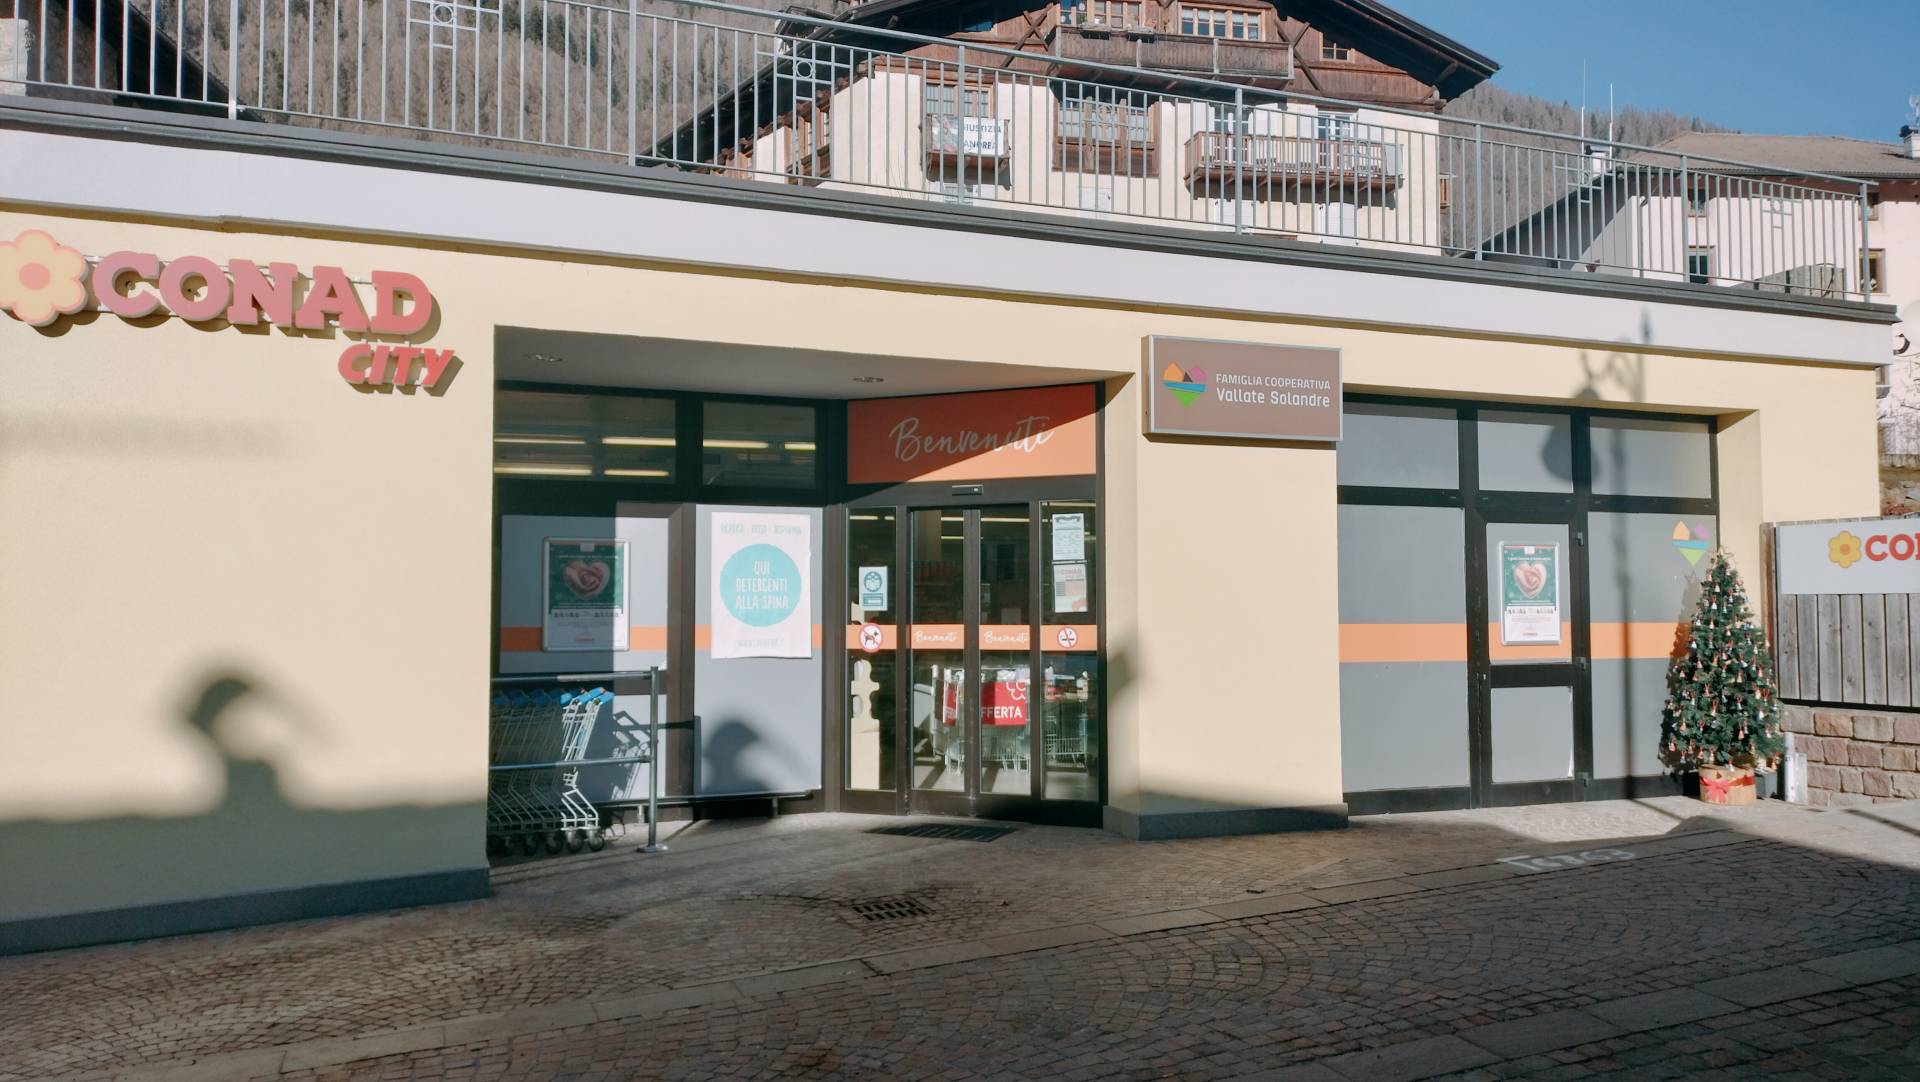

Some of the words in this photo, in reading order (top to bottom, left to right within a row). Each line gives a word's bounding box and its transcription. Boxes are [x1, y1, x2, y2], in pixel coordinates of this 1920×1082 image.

[962, 123, 1002, 134] IUSTIZA
[92, 250, 433, 336] CONAD
[337, 343, 455, 388] CITY
[1215, 373, 1262, 386] FAMIGLIA
[1265, 376, 1331, 390] COOPERATIVA
[1216, 387, 1265, 404] Vallate
[1270, 391, 1331, 407] Solandre
[888, 415, 1056, 462] Benvenuti
[1864, 532, 1920, 562] CO
[753, 560, 770, 576] QUI
[735, 577, 788, 593] DETERGENTI
[735, 594, 759, 609] ALLA
[762, 594, 789, 609] SPINA
[981, 705, 1023, 719] FFERTA
